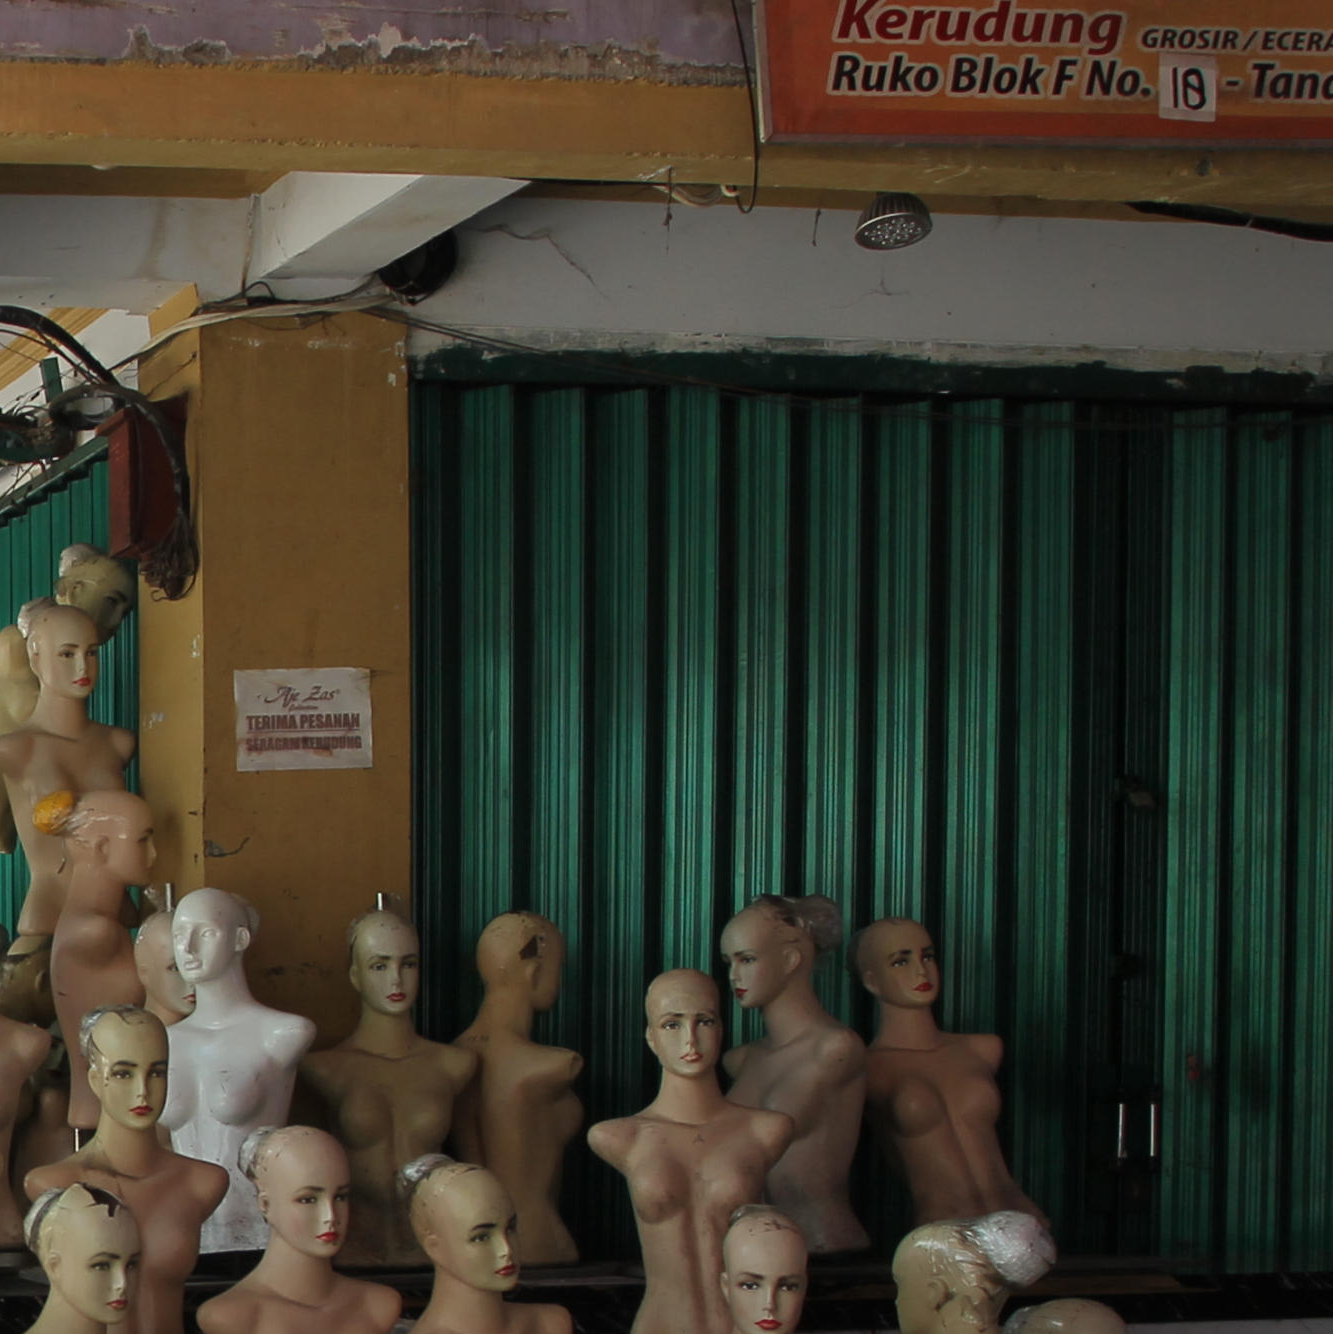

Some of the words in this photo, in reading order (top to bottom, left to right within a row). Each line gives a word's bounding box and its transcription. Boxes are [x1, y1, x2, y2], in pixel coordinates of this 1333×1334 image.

[837, 0, 1123, 56] Kerudung
[1141, 29, 1239, 49] GROSIR
[832, 55, 939, 92] Ruko
[950, 57, 1045, 95] Blok
[1052, 59, 1079, 96] F
[1085, 60, 1151, 97] No.
[246, 715, 297, 730] TERIMA
[299, 713, 360, 729] PESANAN
